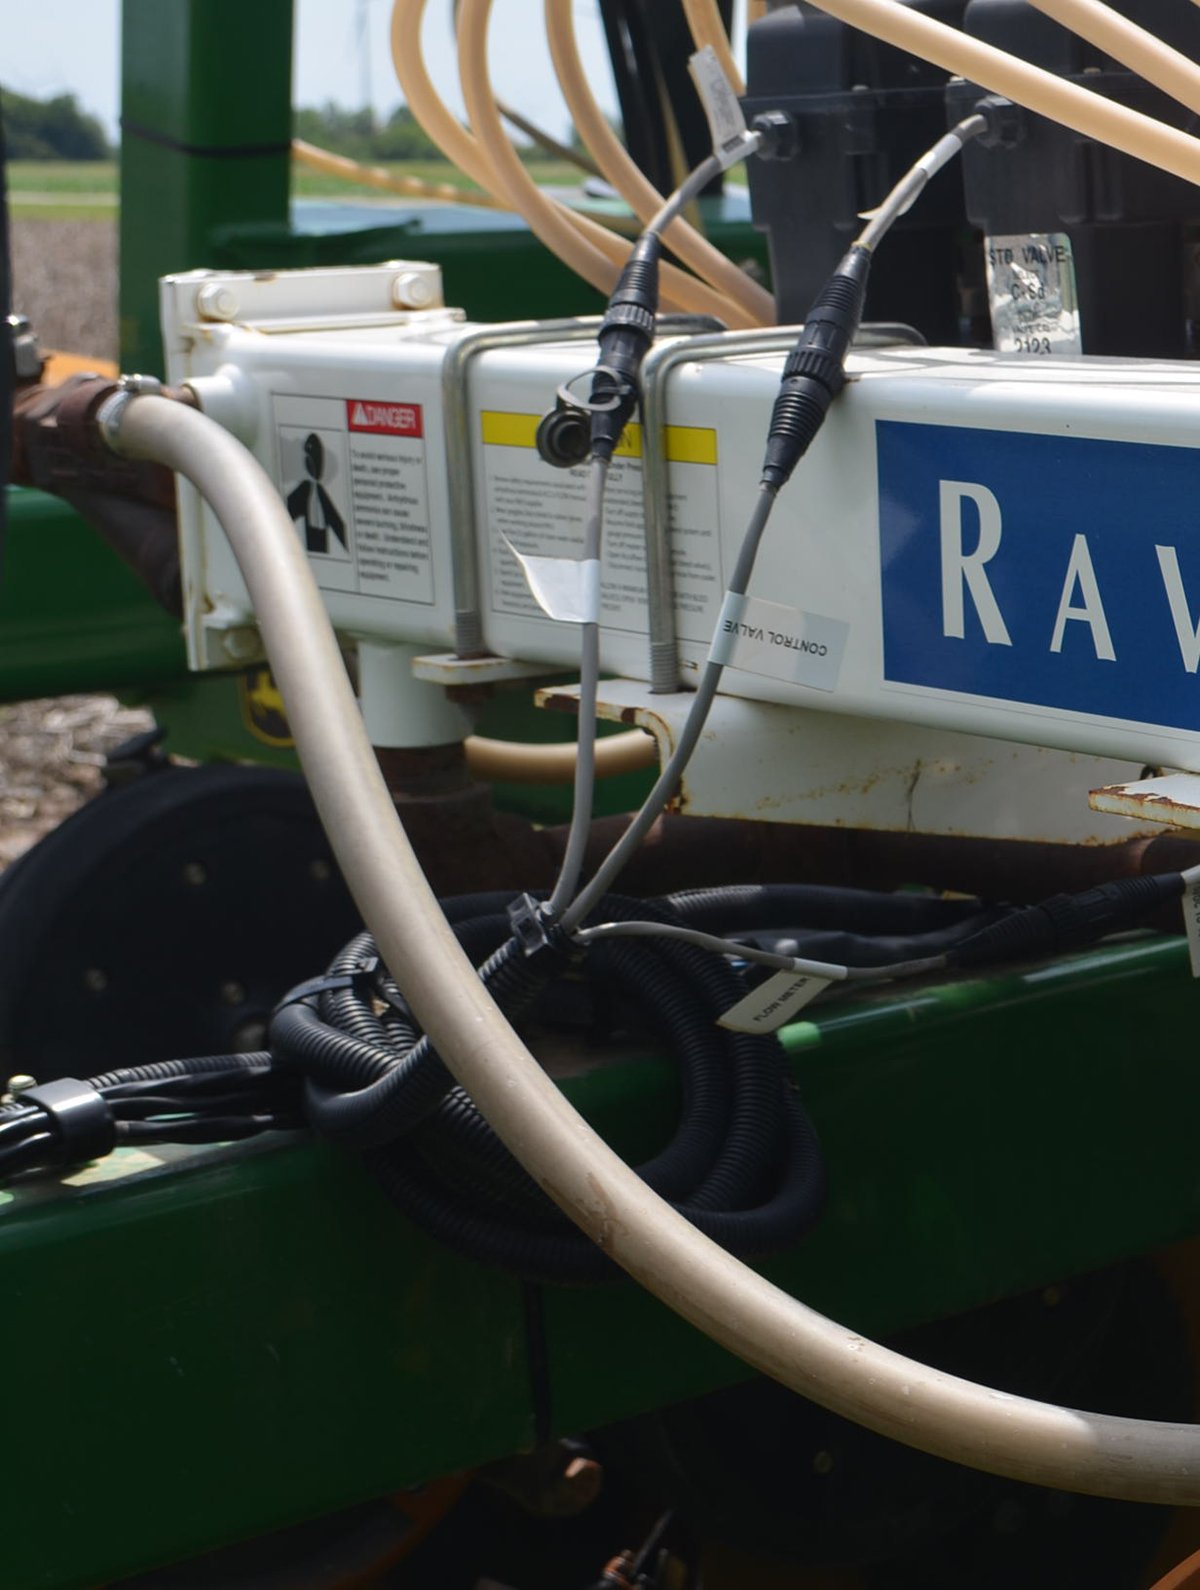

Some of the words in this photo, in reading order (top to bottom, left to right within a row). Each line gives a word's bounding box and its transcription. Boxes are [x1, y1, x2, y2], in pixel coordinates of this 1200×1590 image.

[1022, 245, 1066, 265] VALVE
[366, 405, 417, 429] DANGER
[722, 620, 764, 642] VALVE
[768, 630, 828, 657] CONTROL
[753, 1001, 781, 1022] FLOW
[777, 977, 809, 1002] METER
